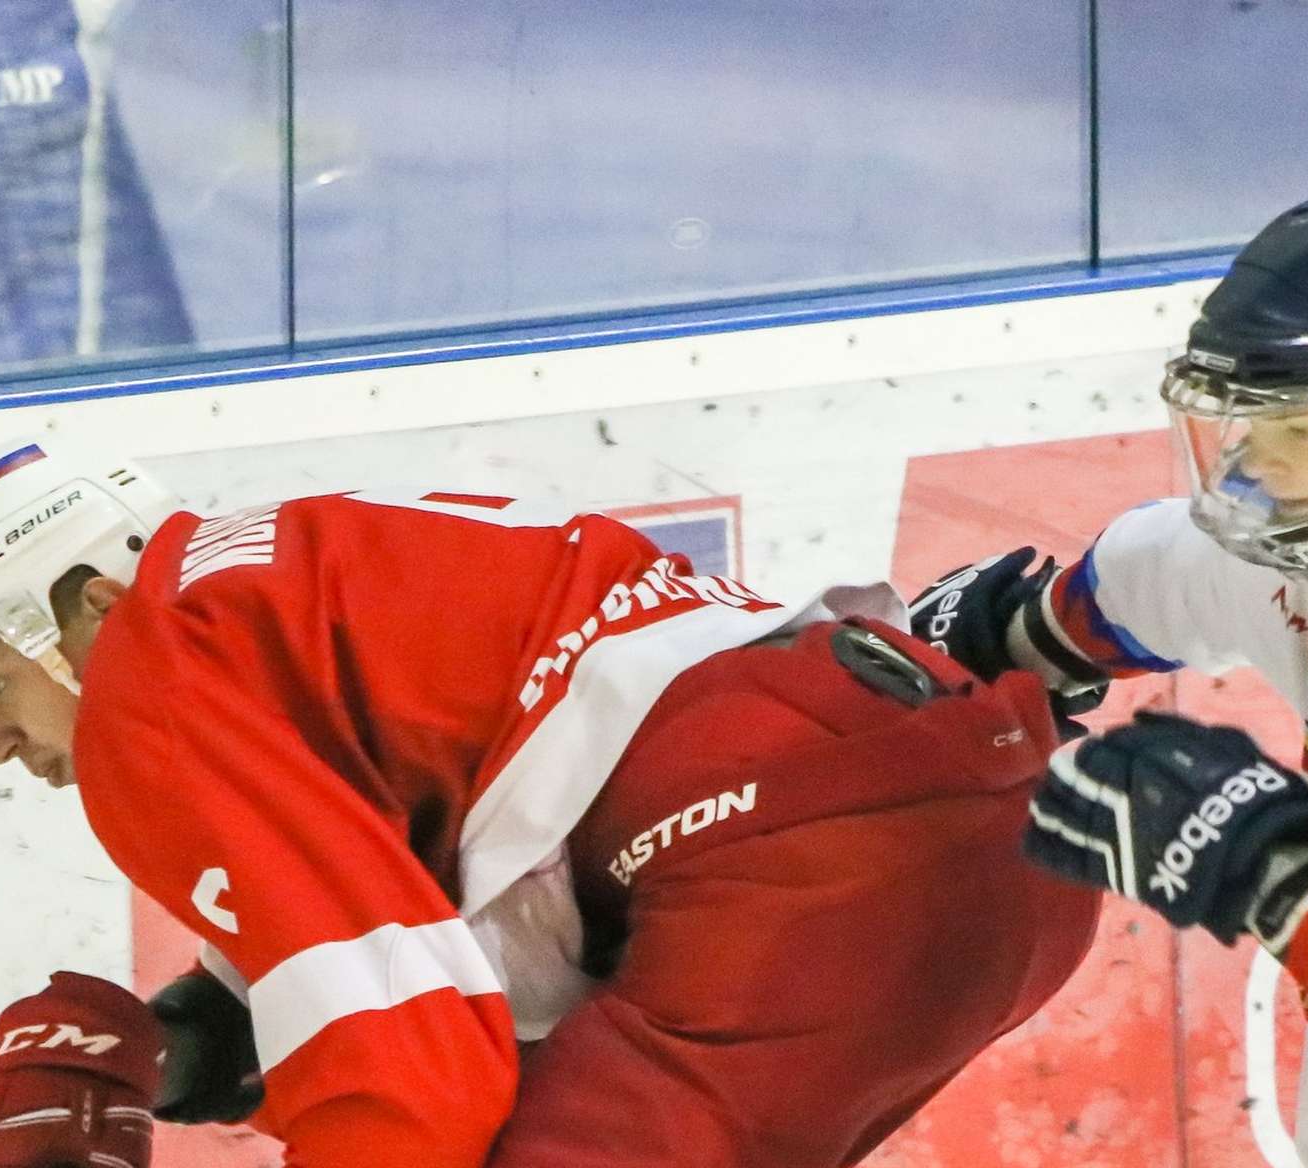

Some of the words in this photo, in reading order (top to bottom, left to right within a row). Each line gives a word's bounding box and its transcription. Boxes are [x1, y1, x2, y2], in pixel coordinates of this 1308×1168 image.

[5, 490, 83, 545] BAUER
[607, 782, 757, 887] EASTON
[1149, 762, 1288, 903] Reebok
